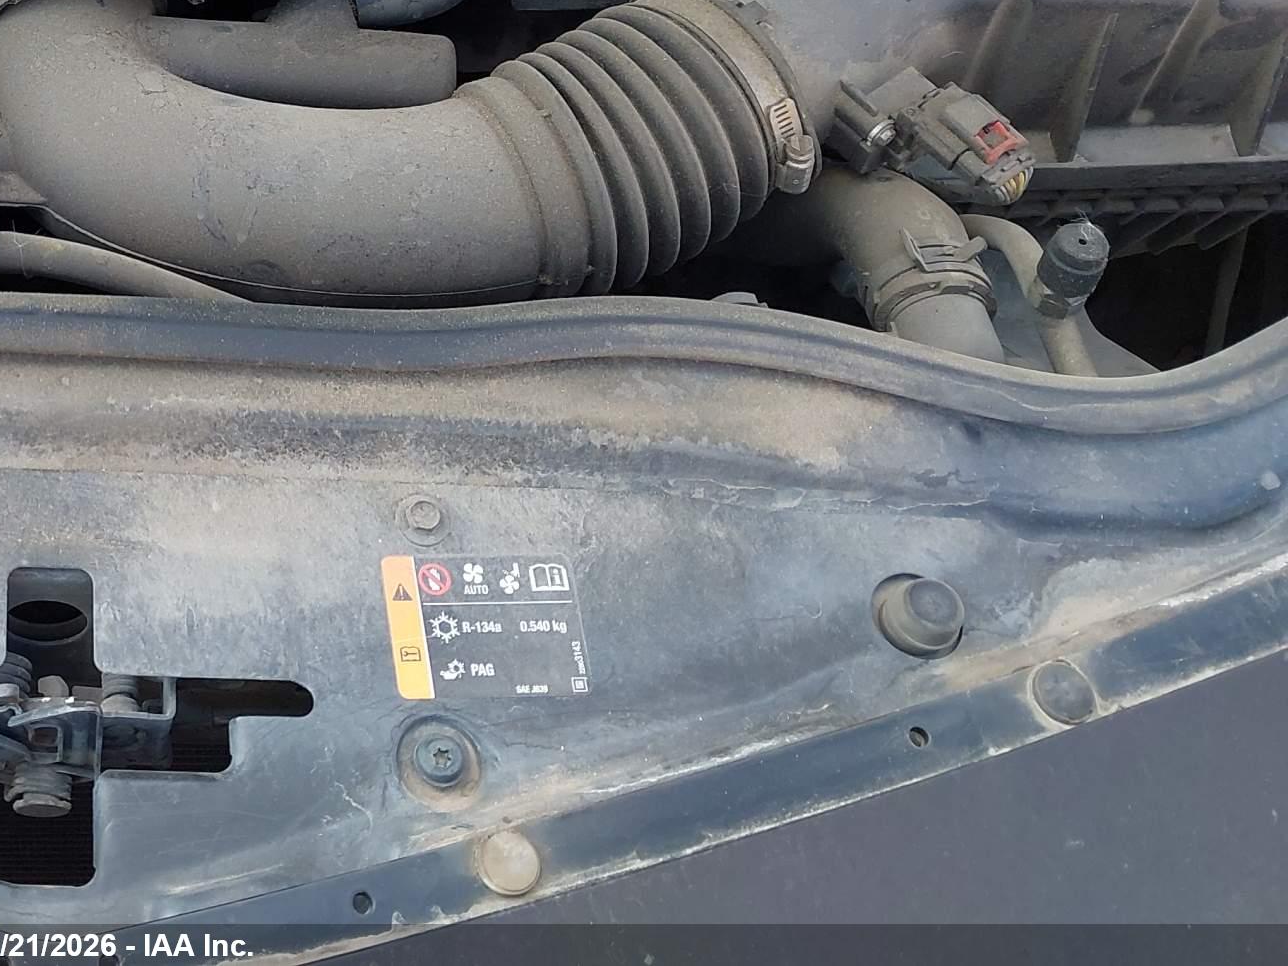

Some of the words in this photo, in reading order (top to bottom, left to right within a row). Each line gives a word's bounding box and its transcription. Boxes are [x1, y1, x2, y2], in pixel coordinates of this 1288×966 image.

[463, 584, 489, 595] AUTO
[462, 621, 502, 633] R-134a
[519, 620, 550, 633] 0.540
[552, 620, 568, 634] kg
[470, 663, 495, 676] PAG
